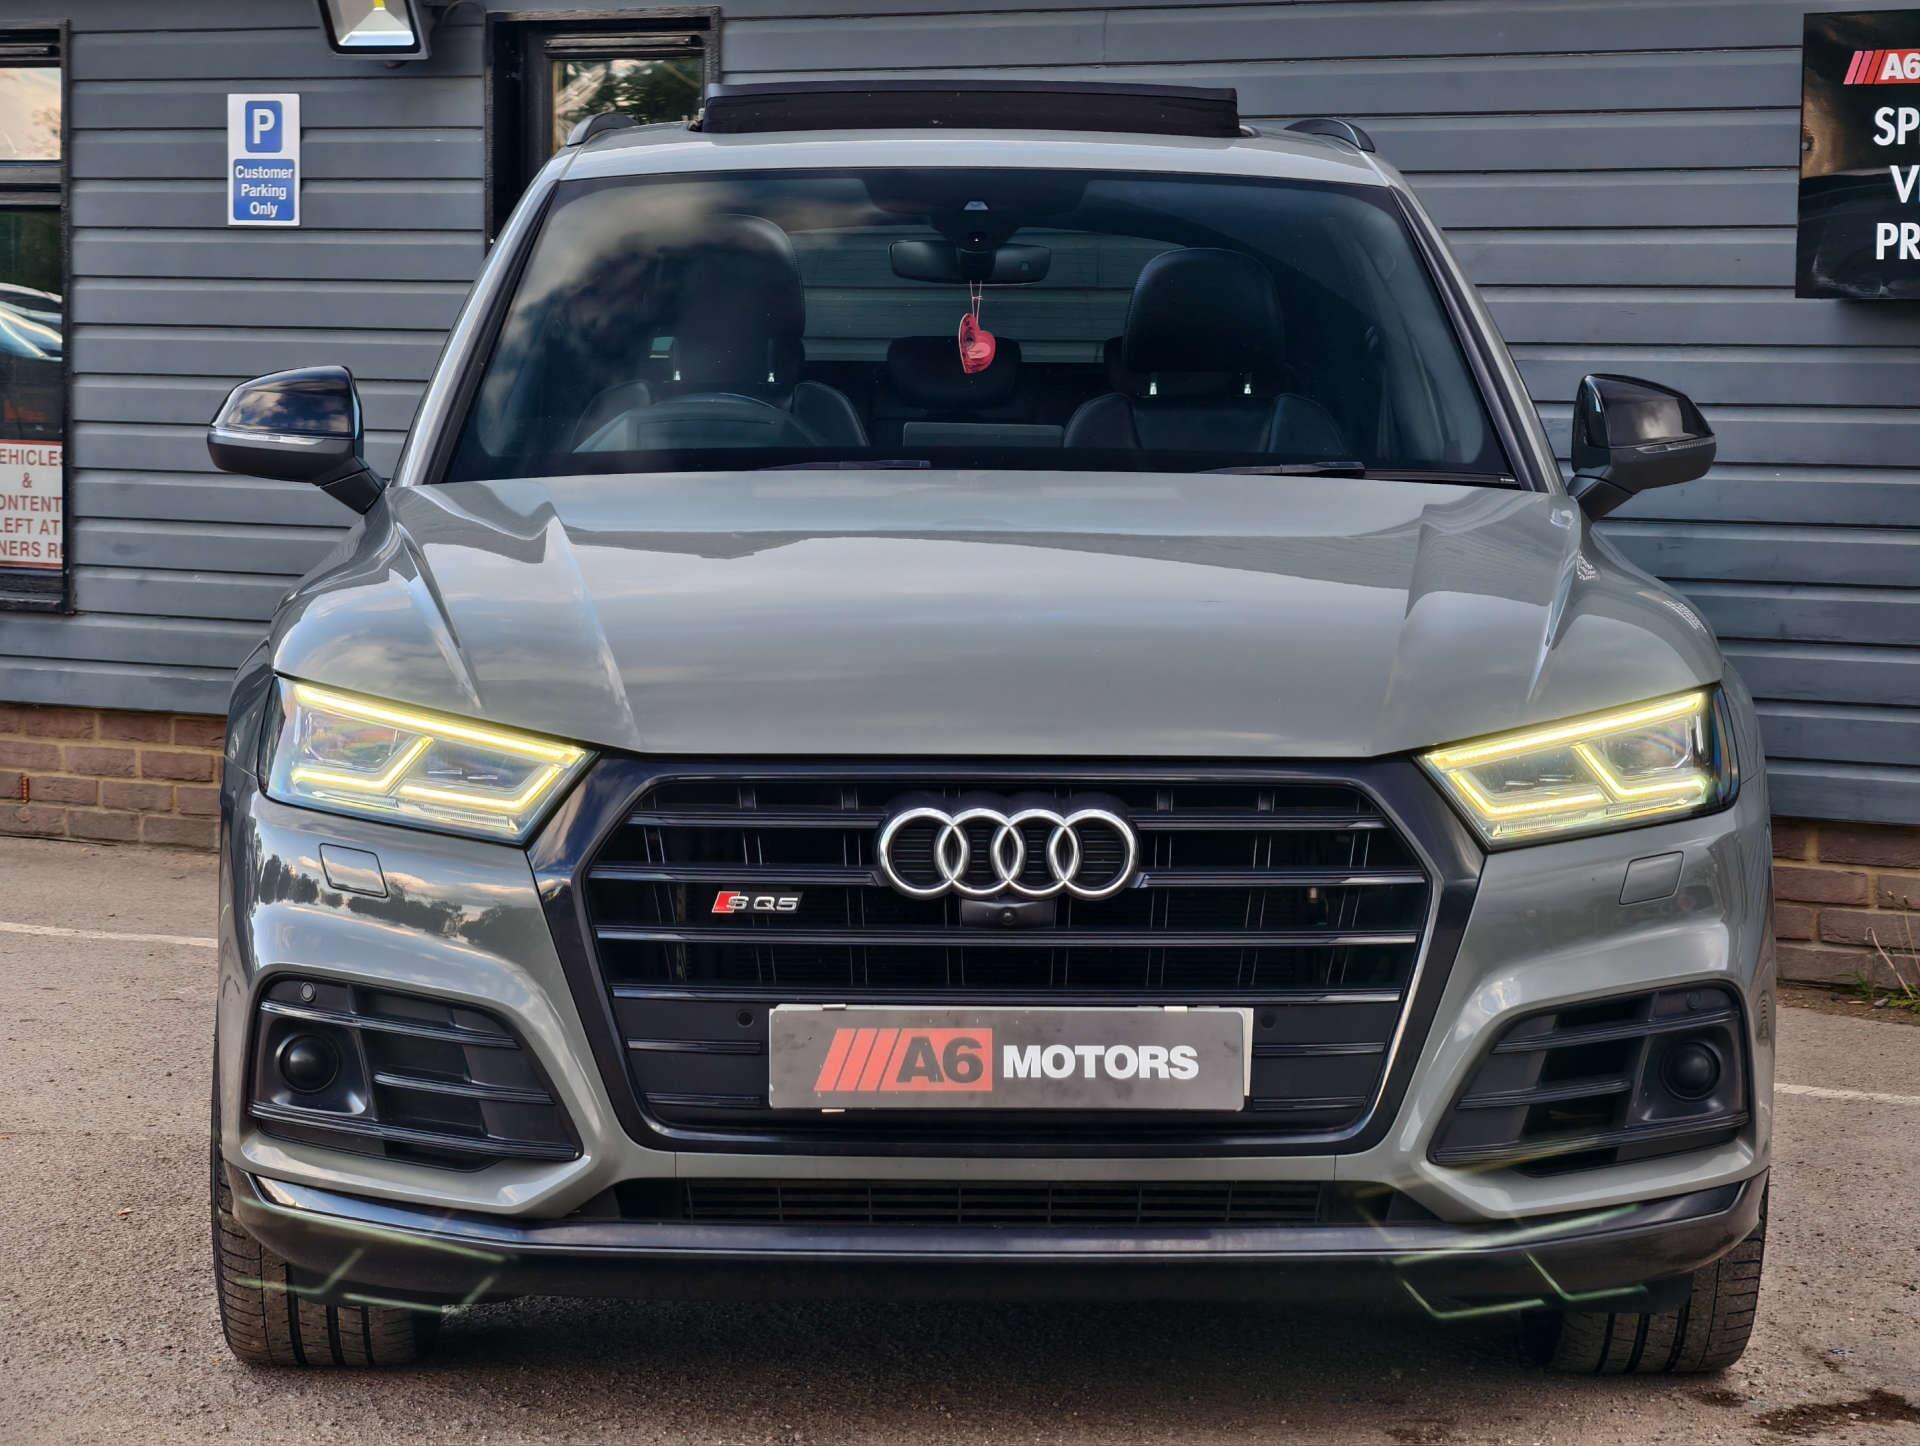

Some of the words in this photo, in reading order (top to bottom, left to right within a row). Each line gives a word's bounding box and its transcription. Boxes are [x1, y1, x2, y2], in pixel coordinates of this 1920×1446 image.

[1881, 52, 1920, 80] A6
[253, 108, 275, 144] P
[235, 165, 293, 178] Customer
[240, 184, 287, 199] Parking
[249, 202, 278, 217] Only
[22, 472, 32, 488] &
[39, 519, 60, 535] AT
[895, 1036, 984, 1083] A6
[1003, 1044, 1199, 1080] MOTORS
